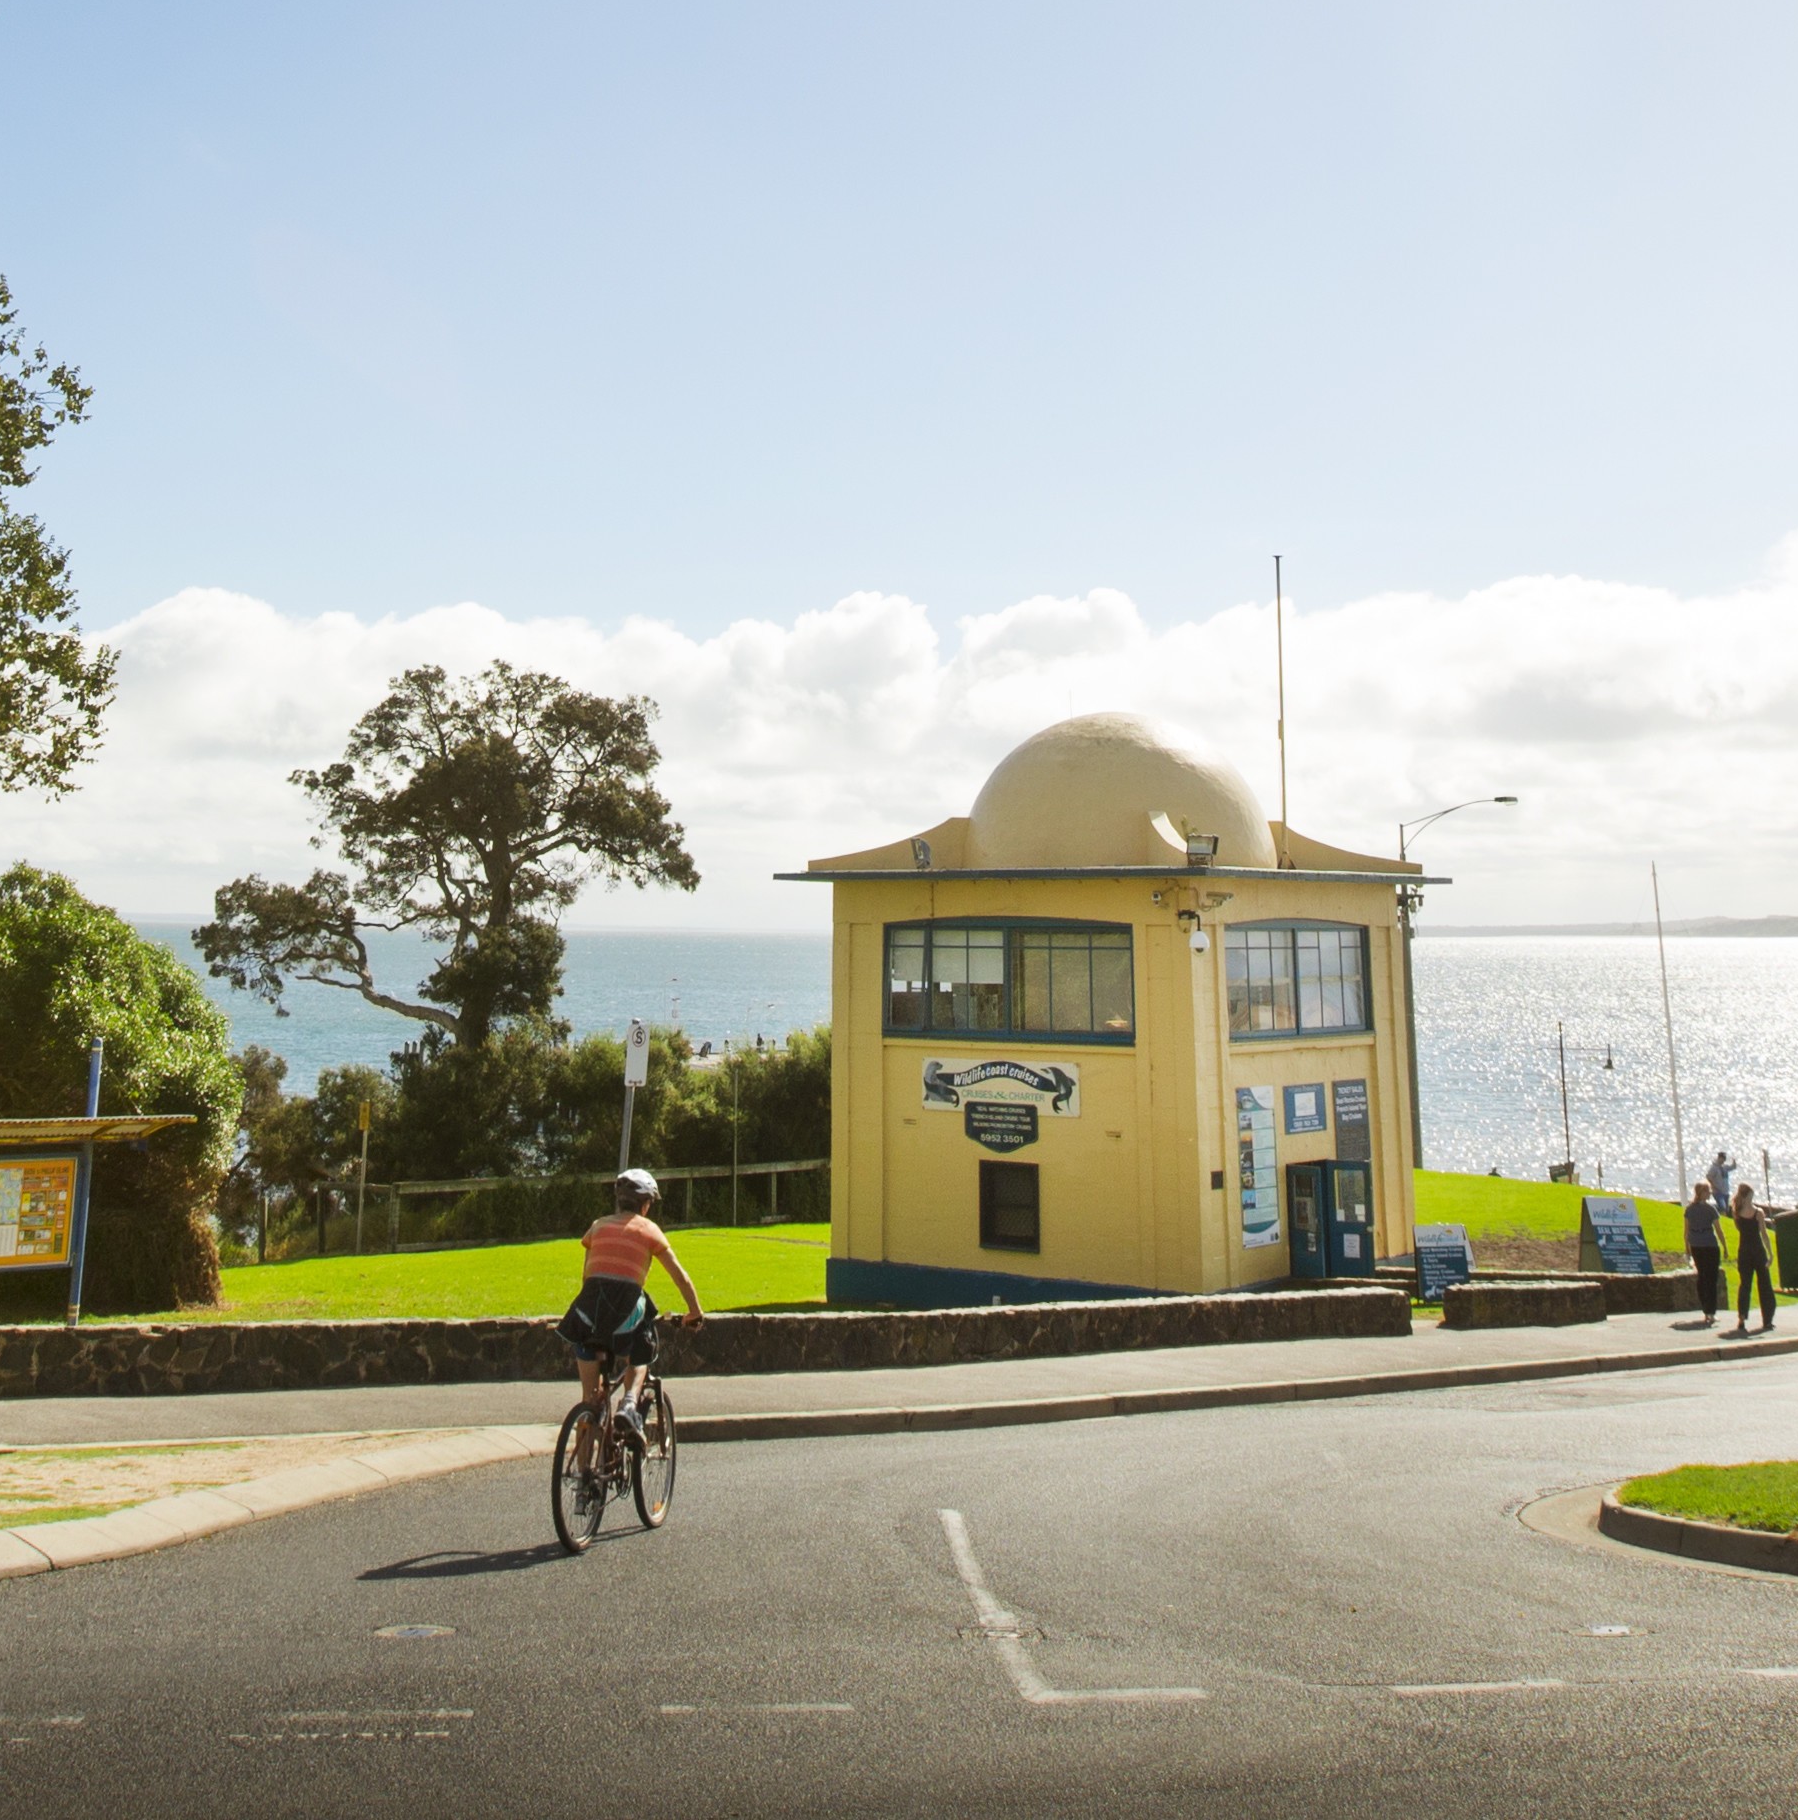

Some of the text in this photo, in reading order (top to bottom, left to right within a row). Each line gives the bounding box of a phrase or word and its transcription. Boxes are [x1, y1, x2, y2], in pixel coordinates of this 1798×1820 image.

[953, 1063, 1039, 1087] Wildlife coast cruises
[962, 1089, 994, 1099] CRUISES
[1008, 1091, 1045, 1102] CHARTER
[980, 1133, 1024, 1143] 5952 3501
